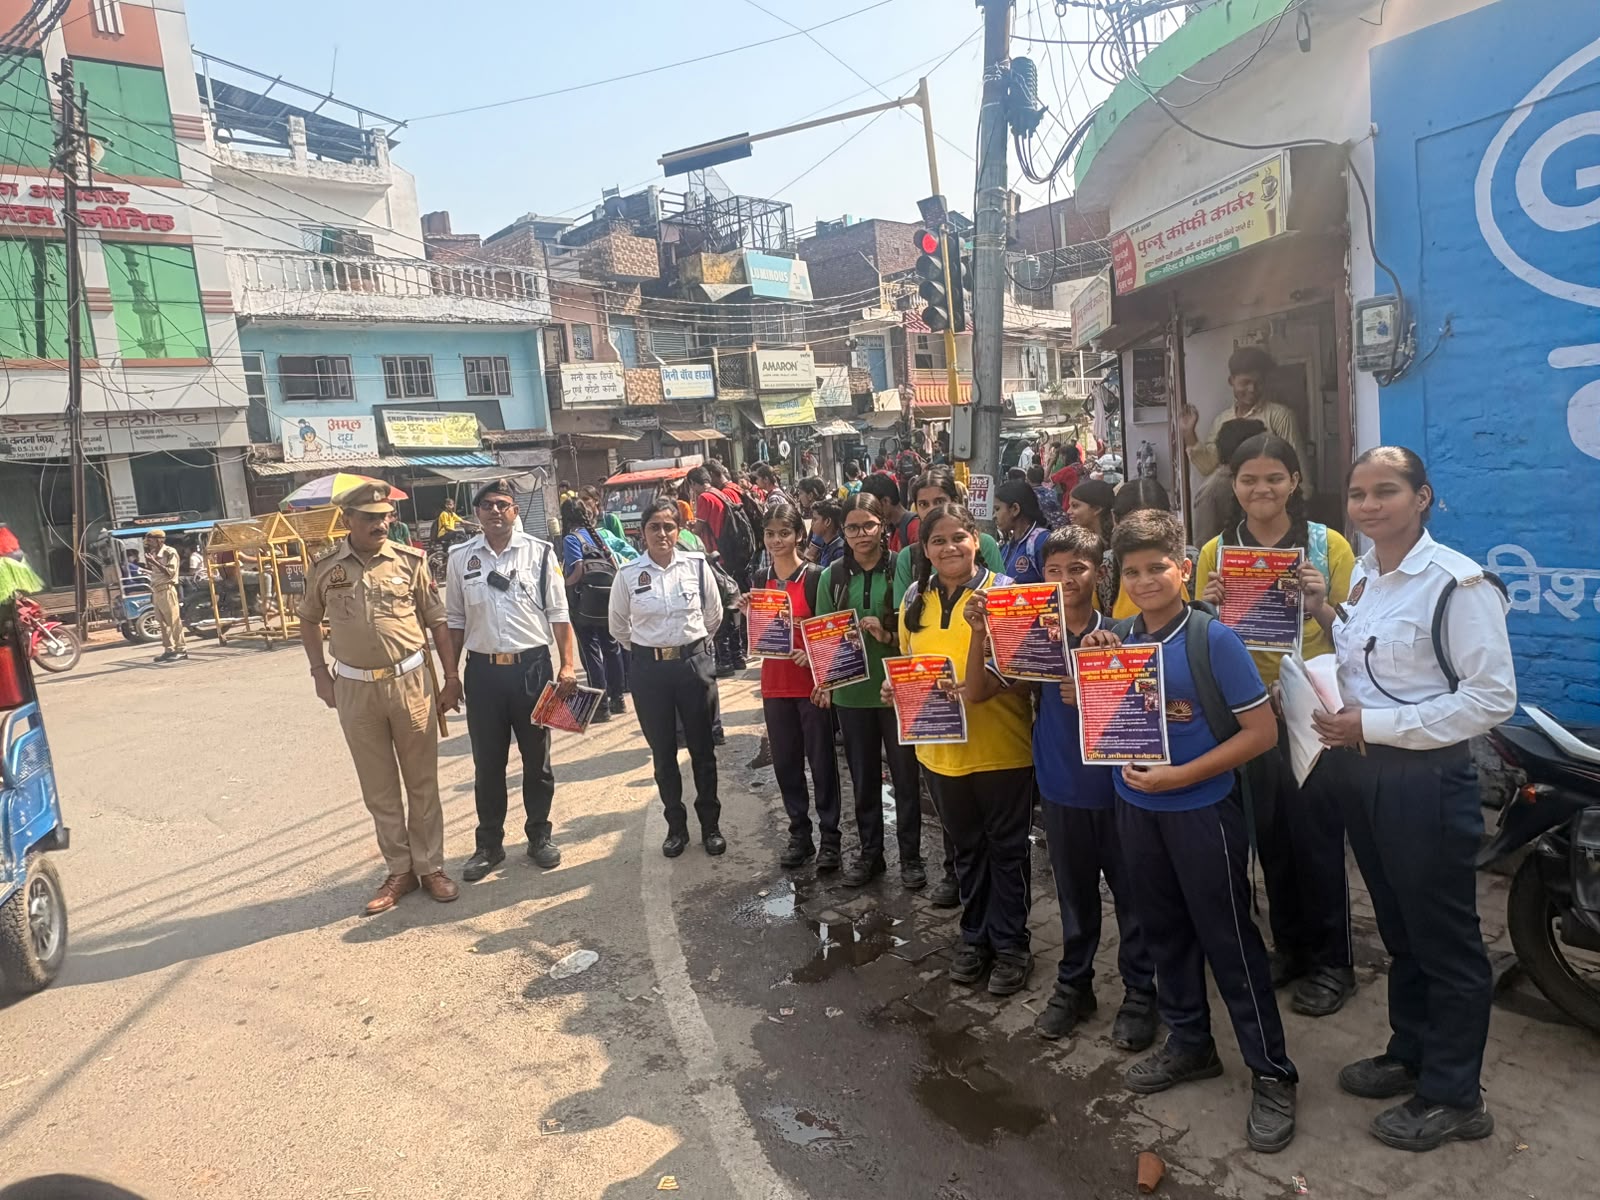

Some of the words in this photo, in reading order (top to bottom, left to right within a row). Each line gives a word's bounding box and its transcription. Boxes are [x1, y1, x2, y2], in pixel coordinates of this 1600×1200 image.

[762, 361, 798, 371] AMARON
[328, 418, 361, 432] अमूल
[337, 433, 353, 445] दूध
